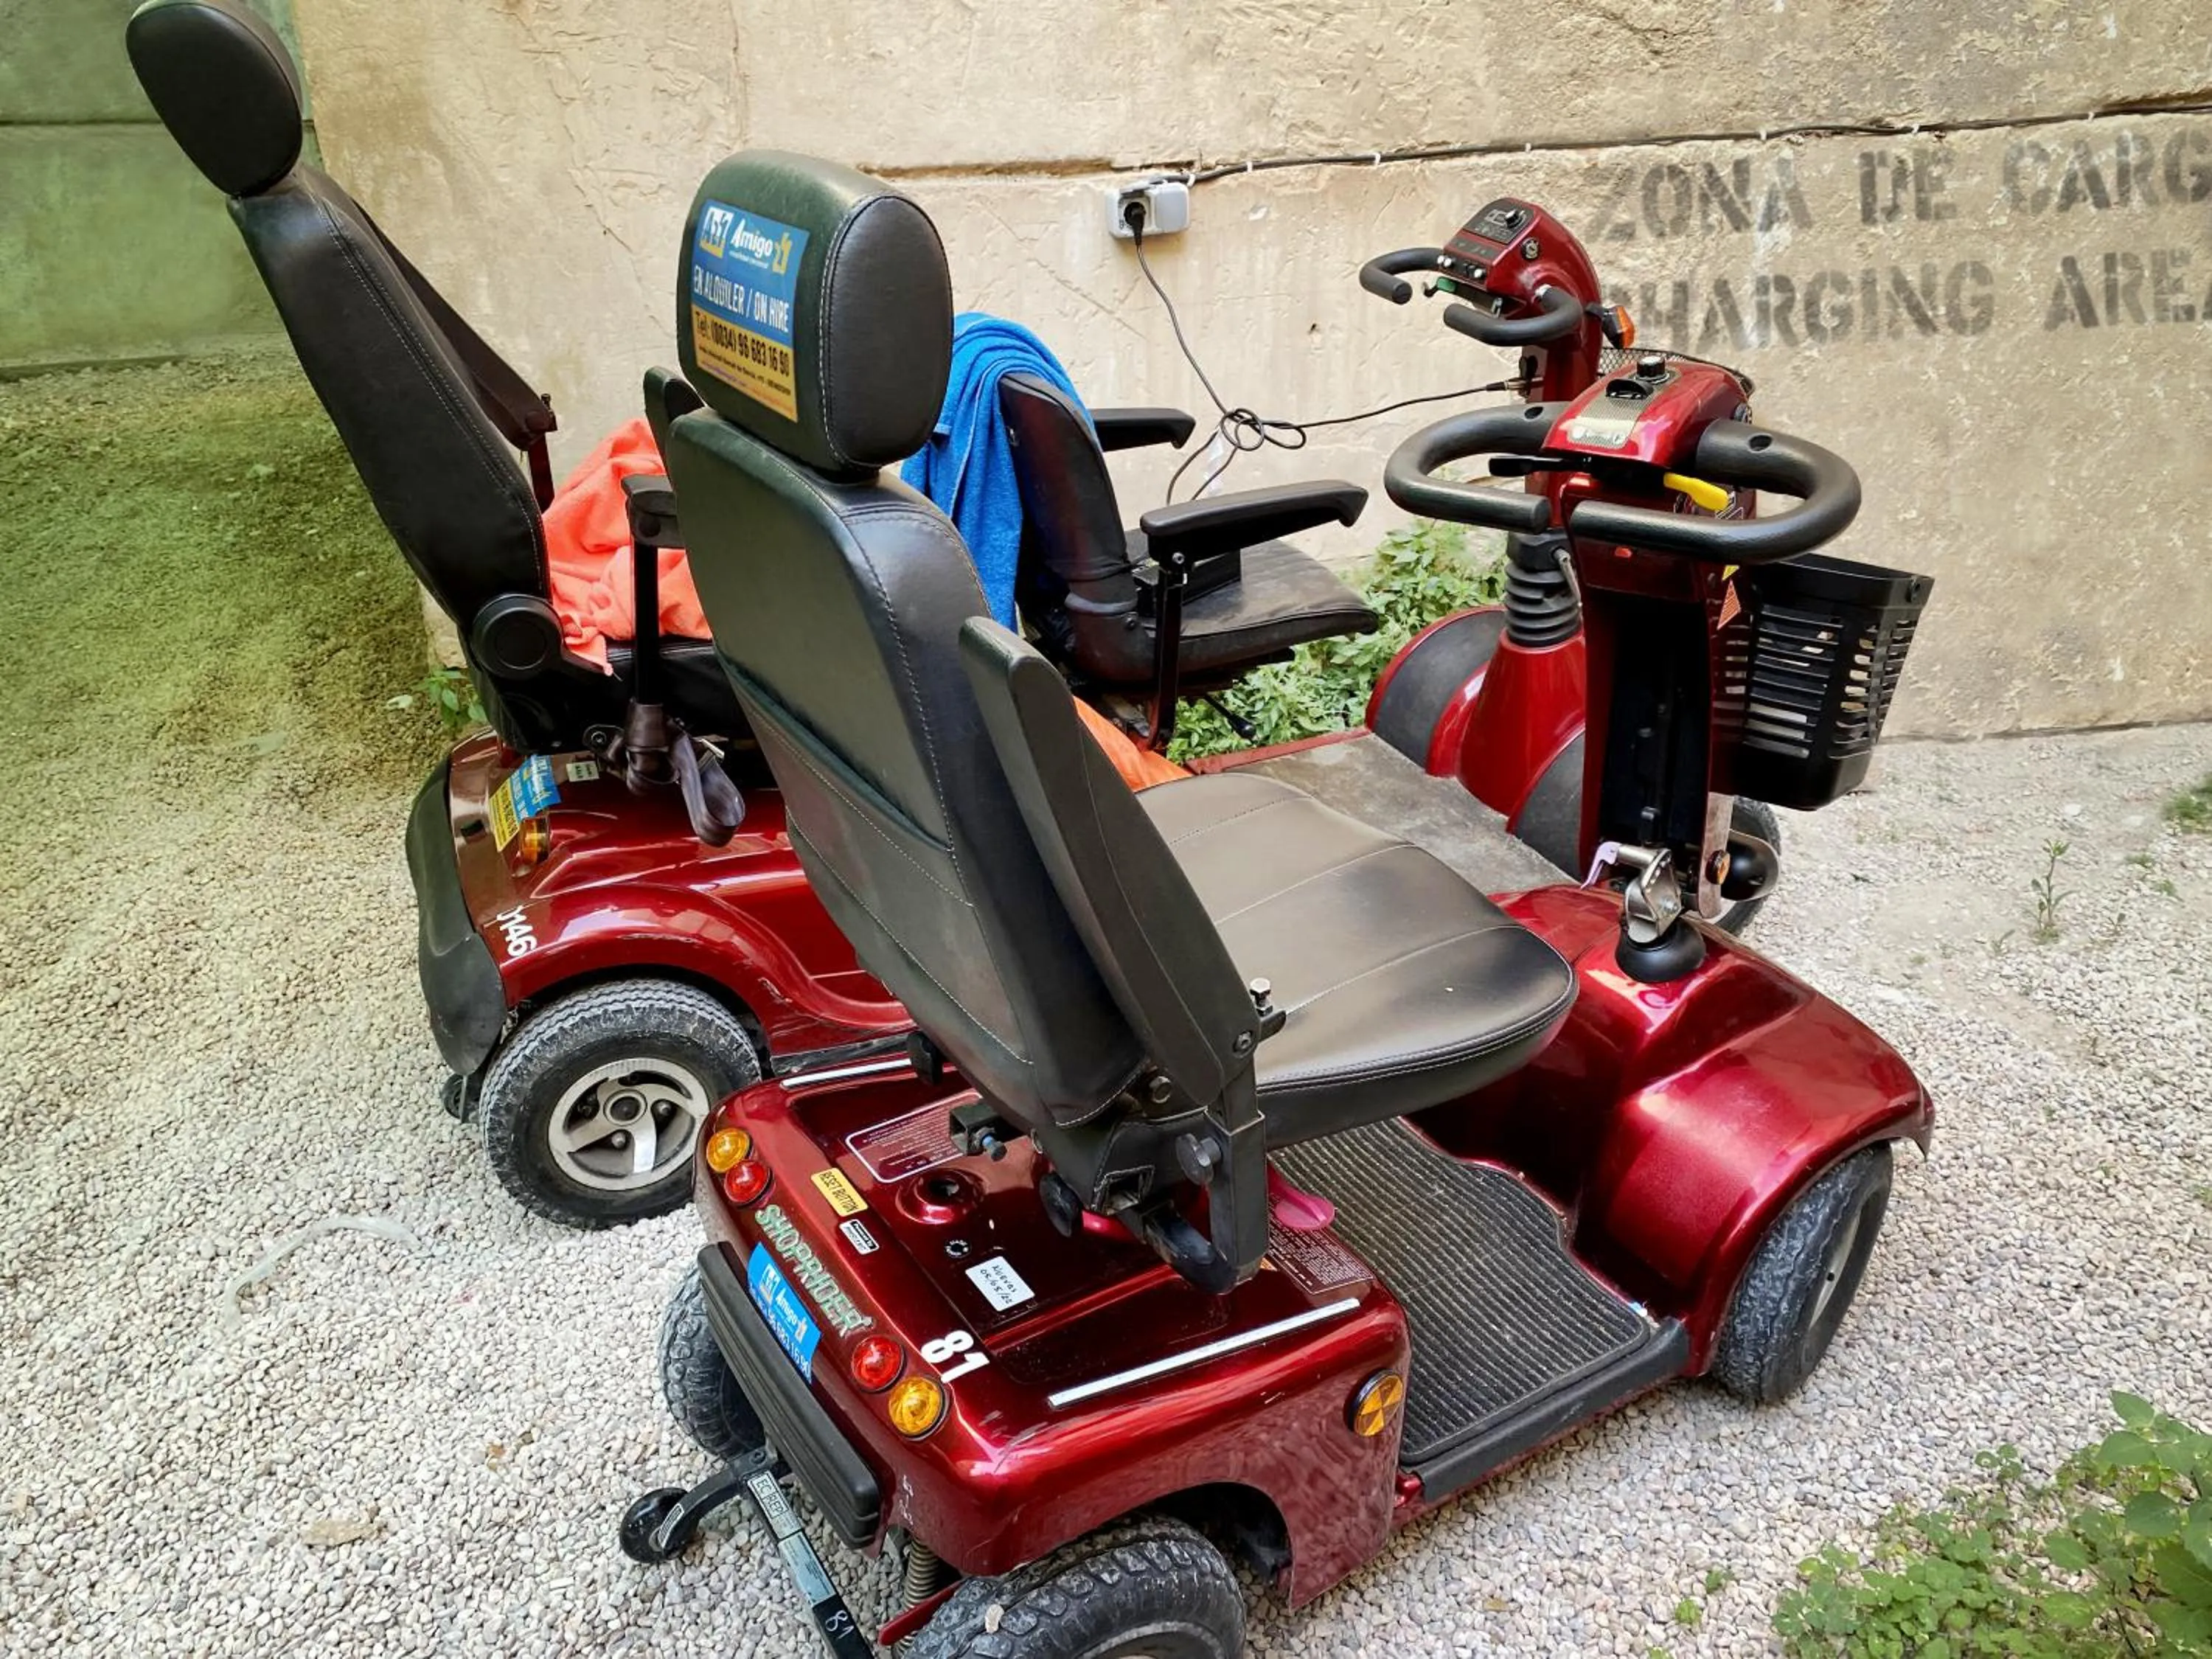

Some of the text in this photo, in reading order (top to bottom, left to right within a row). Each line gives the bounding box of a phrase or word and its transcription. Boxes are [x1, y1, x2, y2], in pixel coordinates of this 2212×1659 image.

[1582, 129, 2212, 243] ZONA DE CARG
[731, 218, 773, 258] Amigo
[703, 271, 745, 316] ALQUILER
[754, 291, 768, 324] ON
[769, 296, 790, 333] HIRE
[2043, 248, 2212, 332] ARE
[755, 1204, 872, 1338] SHOPRIDER
[921, 1329, 990, 1384] 81
[756, 1478, 785, 1514] EC REP
[826, 1610, 855, 1640] 81
